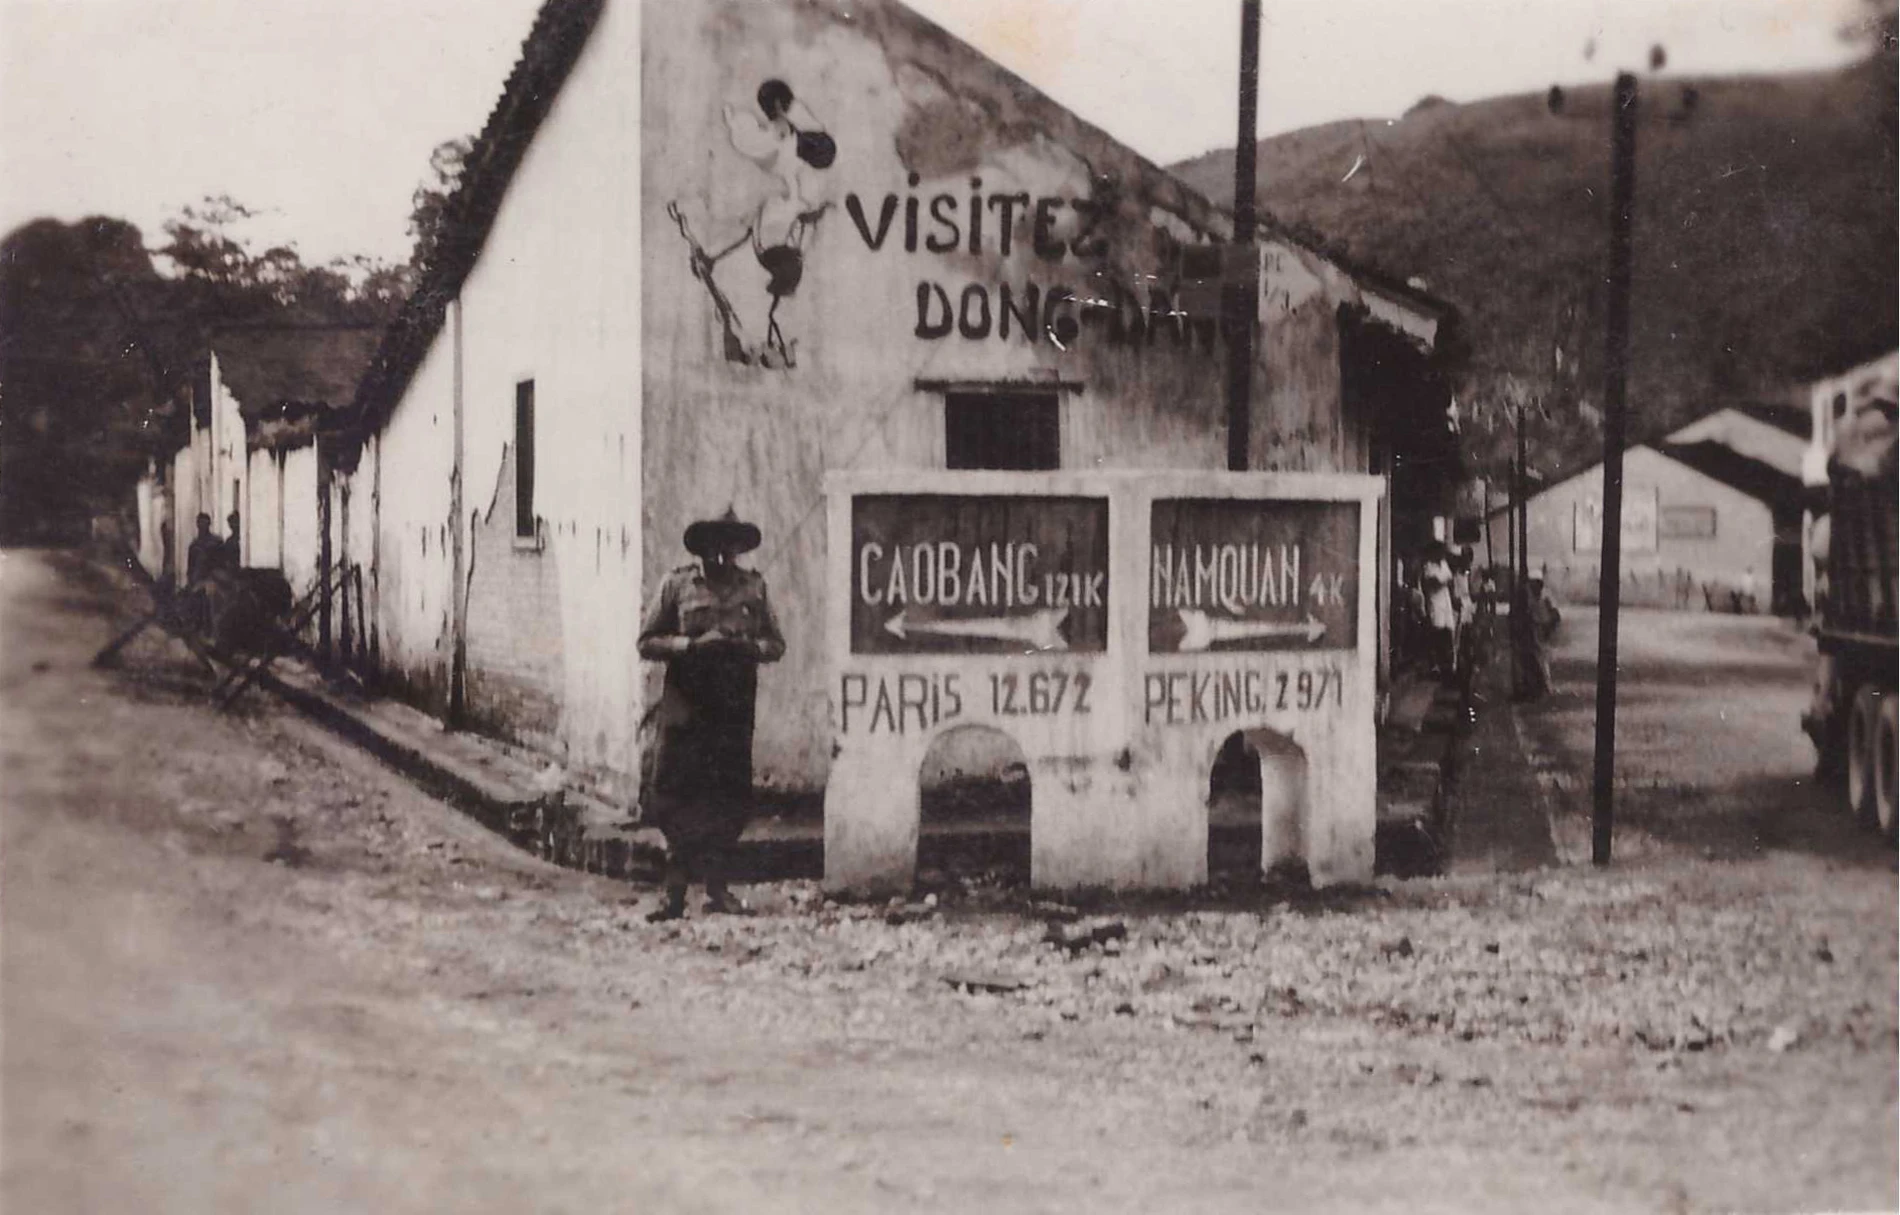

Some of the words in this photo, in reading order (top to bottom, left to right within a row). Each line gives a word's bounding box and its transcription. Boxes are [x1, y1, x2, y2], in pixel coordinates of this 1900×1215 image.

[859, 541, 1039, 606] CAOBANG
[1045, 572, 1103, 607] 121K
[1153, 544, 1300, 614] NAMQUAN
[1309, 573, 1345, 606] 4K
[841, 671, 962, 735] PARIS
[989, 669, 1092, 717] 12.672
